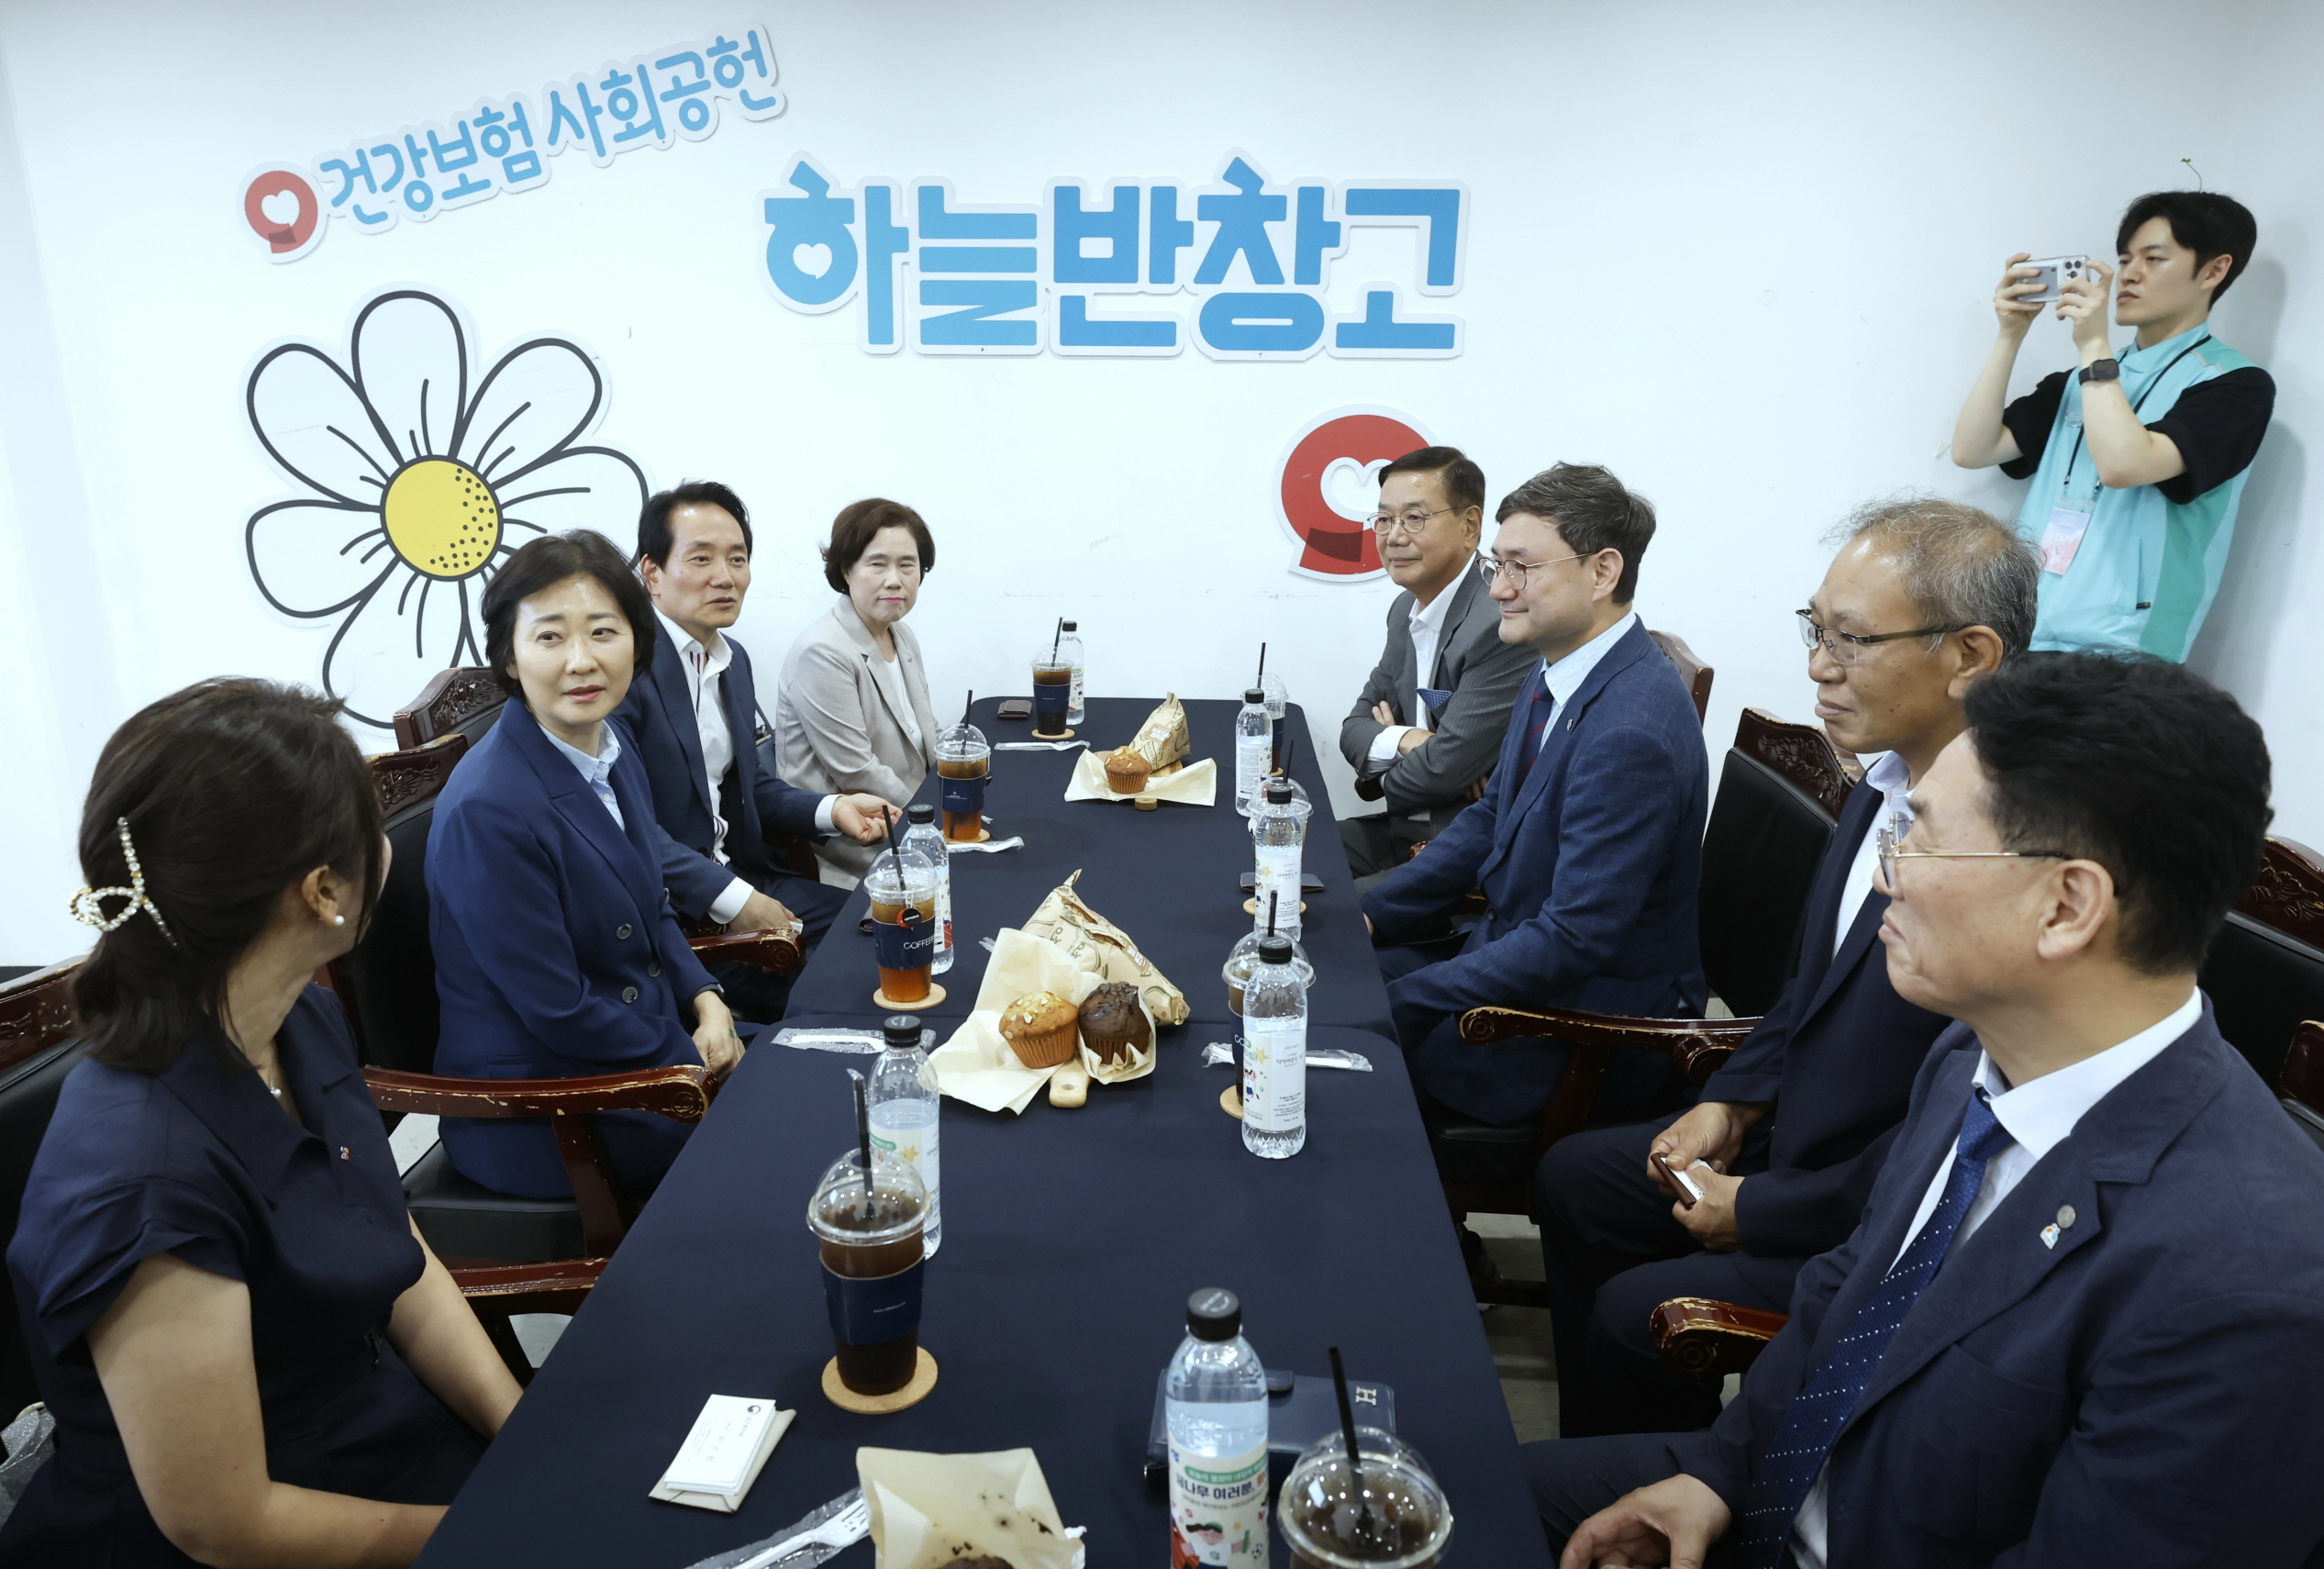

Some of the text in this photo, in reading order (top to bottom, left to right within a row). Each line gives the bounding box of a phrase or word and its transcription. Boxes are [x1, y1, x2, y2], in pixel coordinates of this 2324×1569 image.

[320, 30, 775, 224] 건강보험 사회공헌
[765, 157, 1460, 351] 하늘반창고
[2048, 532, 2076, 544] STAFF
